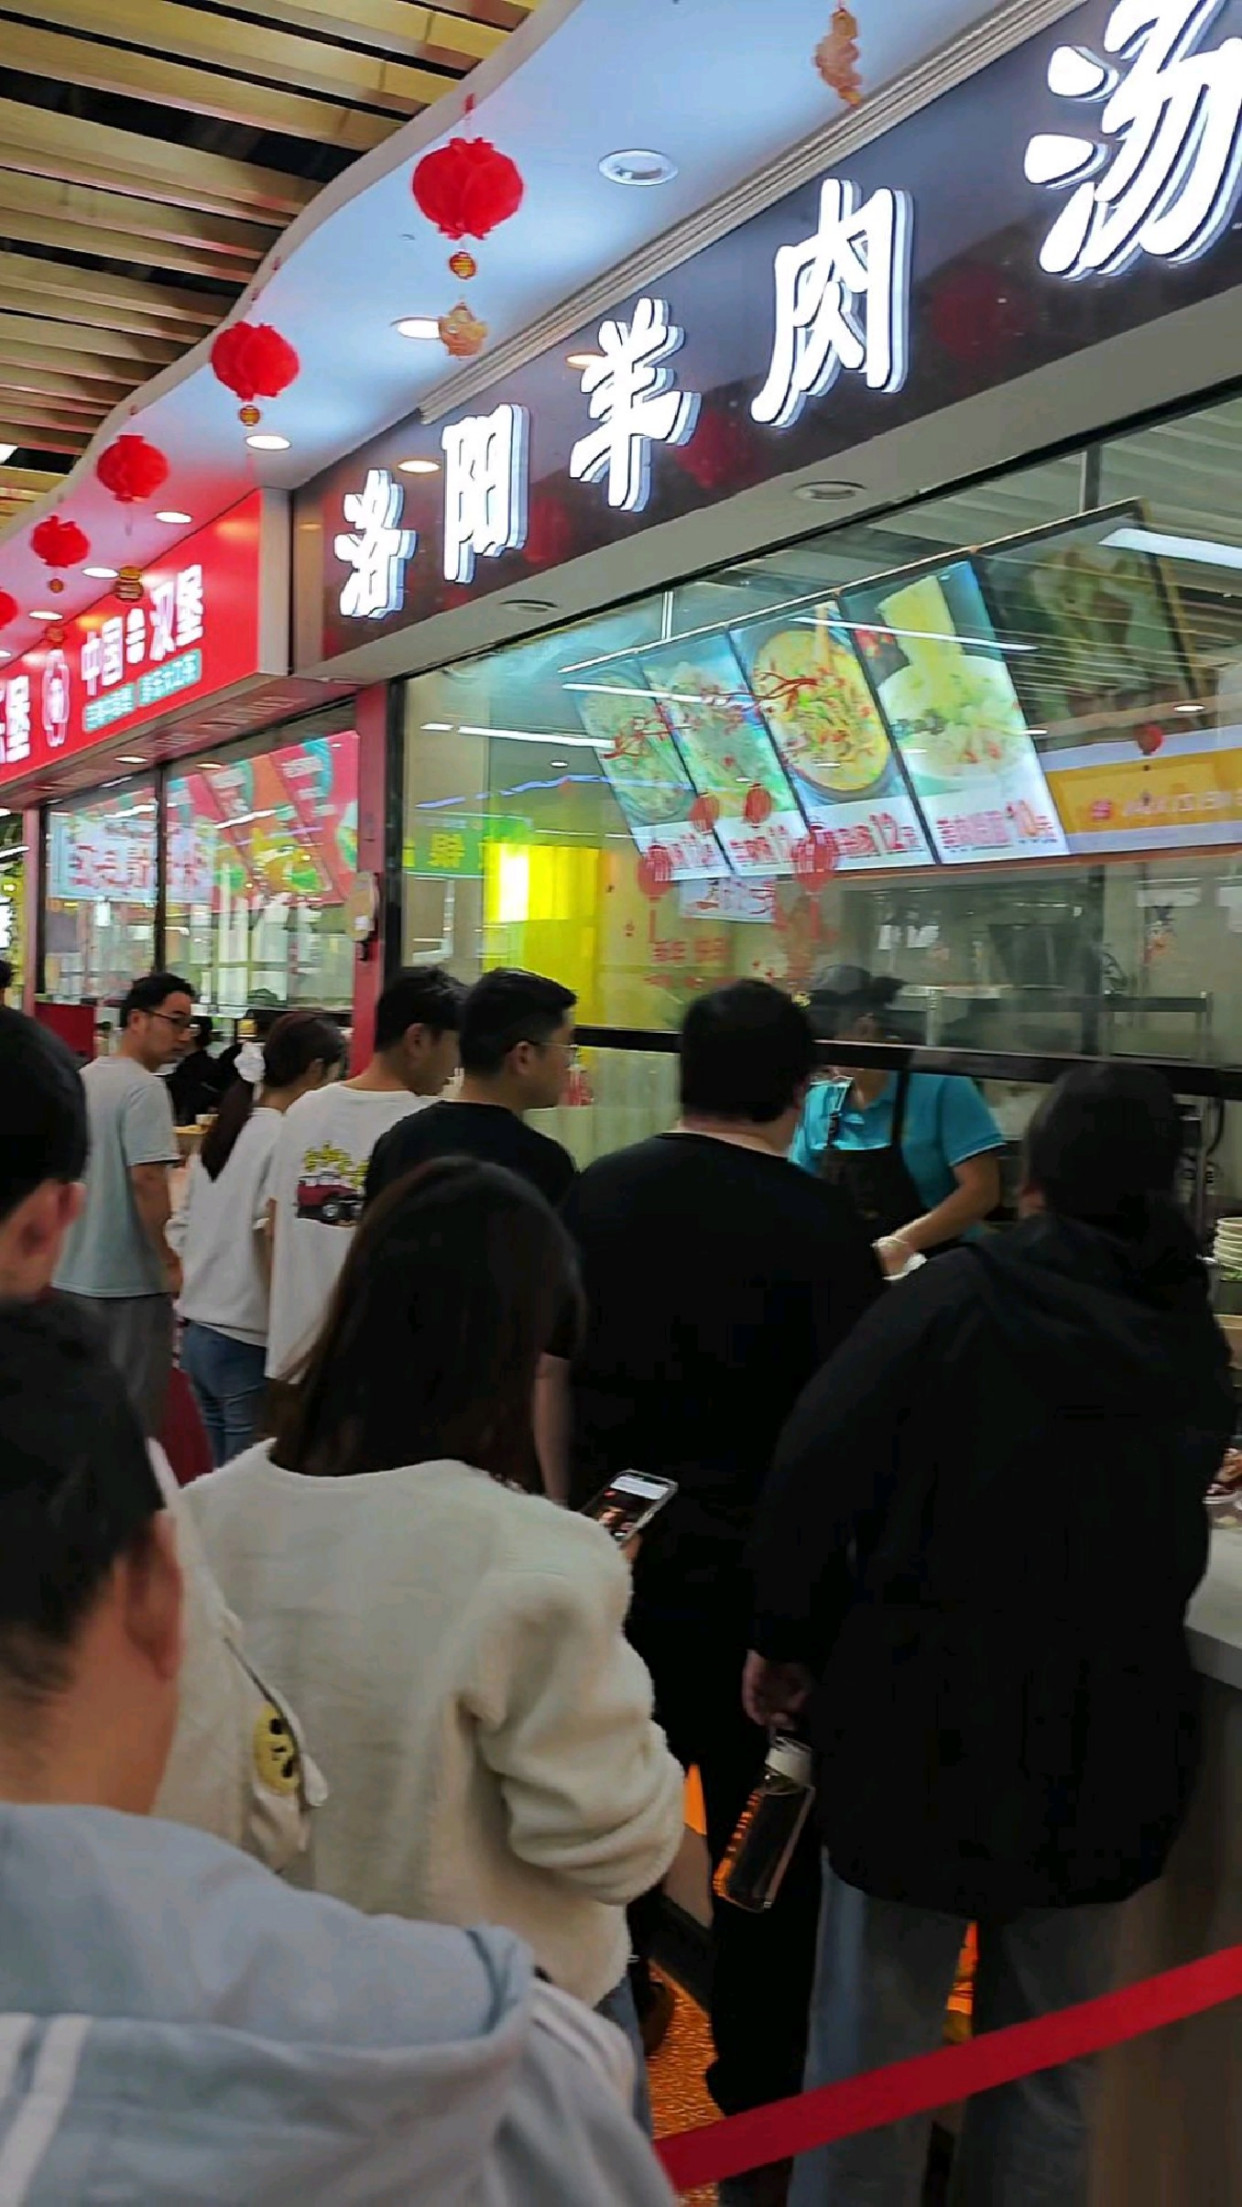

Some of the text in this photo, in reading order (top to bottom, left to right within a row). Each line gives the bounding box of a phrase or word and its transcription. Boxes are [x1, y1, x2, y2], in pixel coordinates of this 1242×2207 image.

[335, 0, 1242, 622] 洛阳羊肉汤
